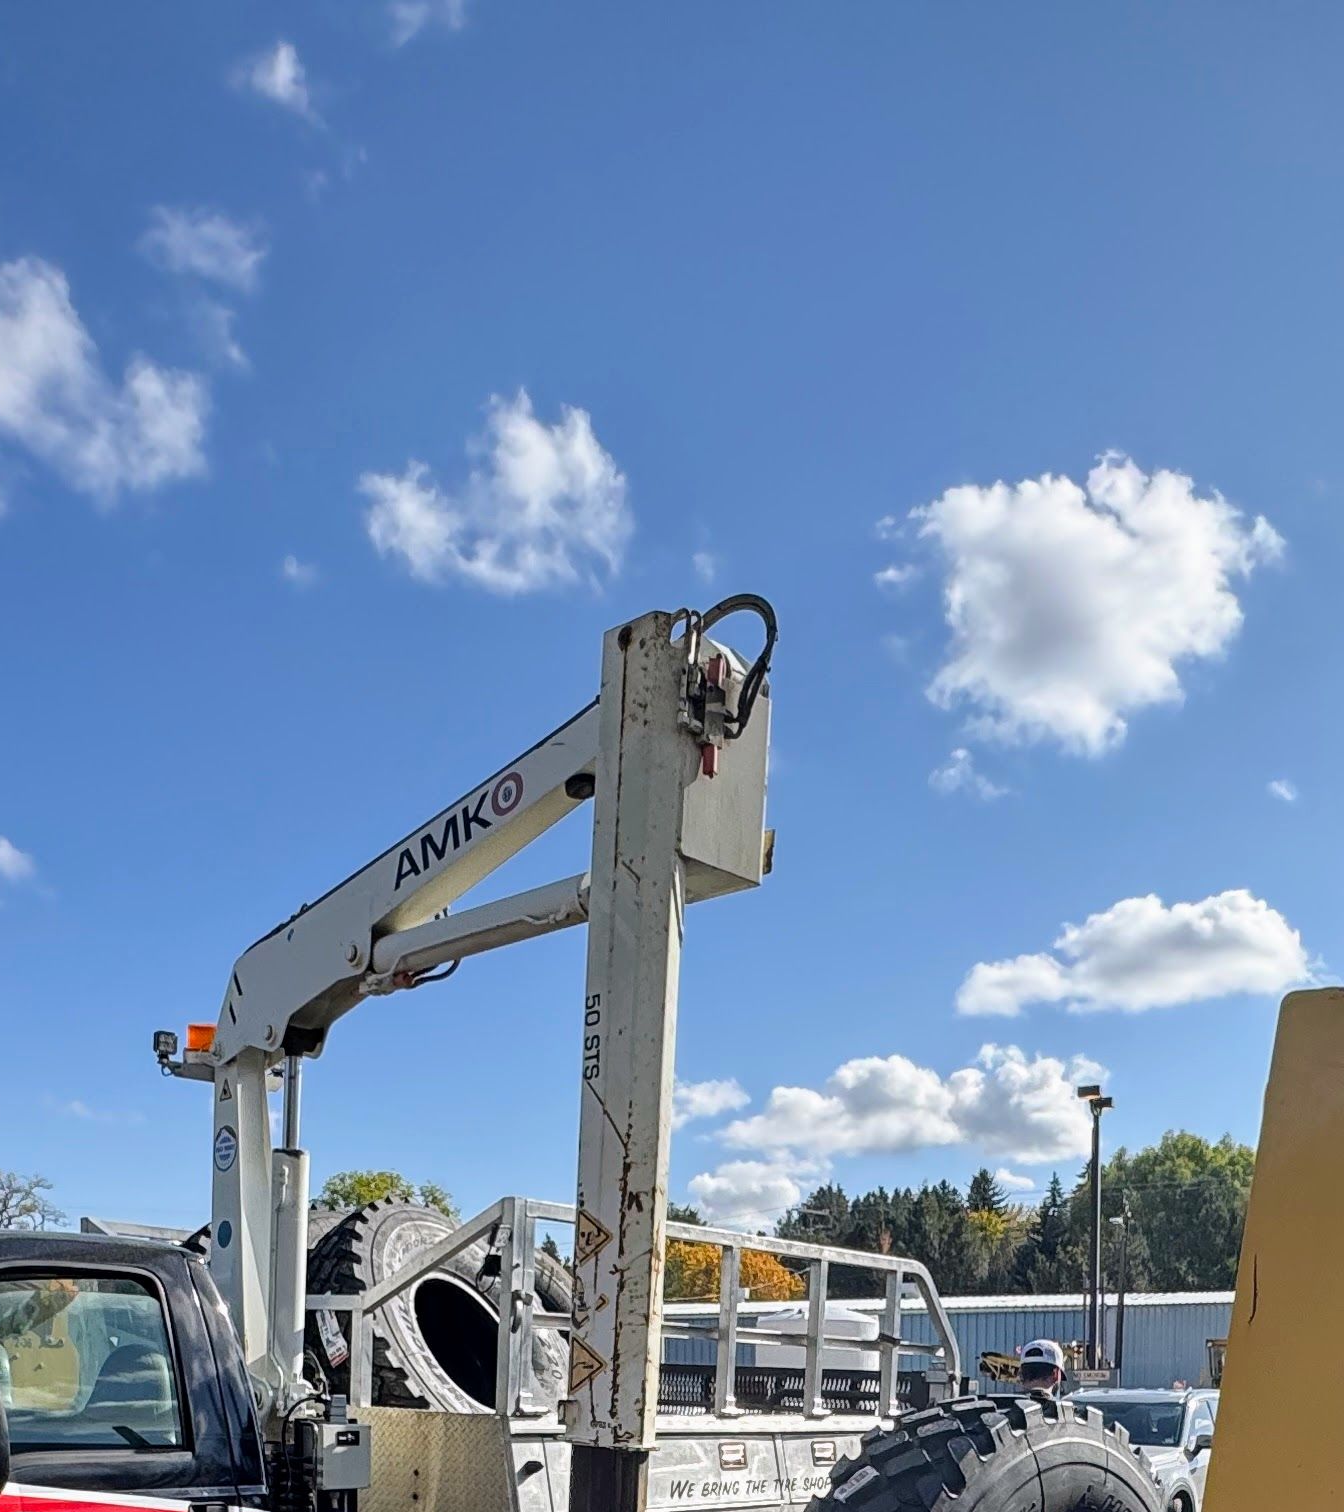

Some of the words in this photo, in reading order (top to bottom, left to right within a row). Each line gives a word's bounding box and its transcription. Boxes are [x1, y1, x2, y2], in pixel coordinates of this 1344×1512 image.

[394, 771, 523, 891] AMKO
[584, 993, 601, 1027] 50
[583, 1034, 601, 1080] STS
[669, 1479, 696, 1500] WE
[701, 1481, 740, 1497] BRING
[745, 1479, 768, 1495] THE
[803, 1476, 832, 1492] SHOP
